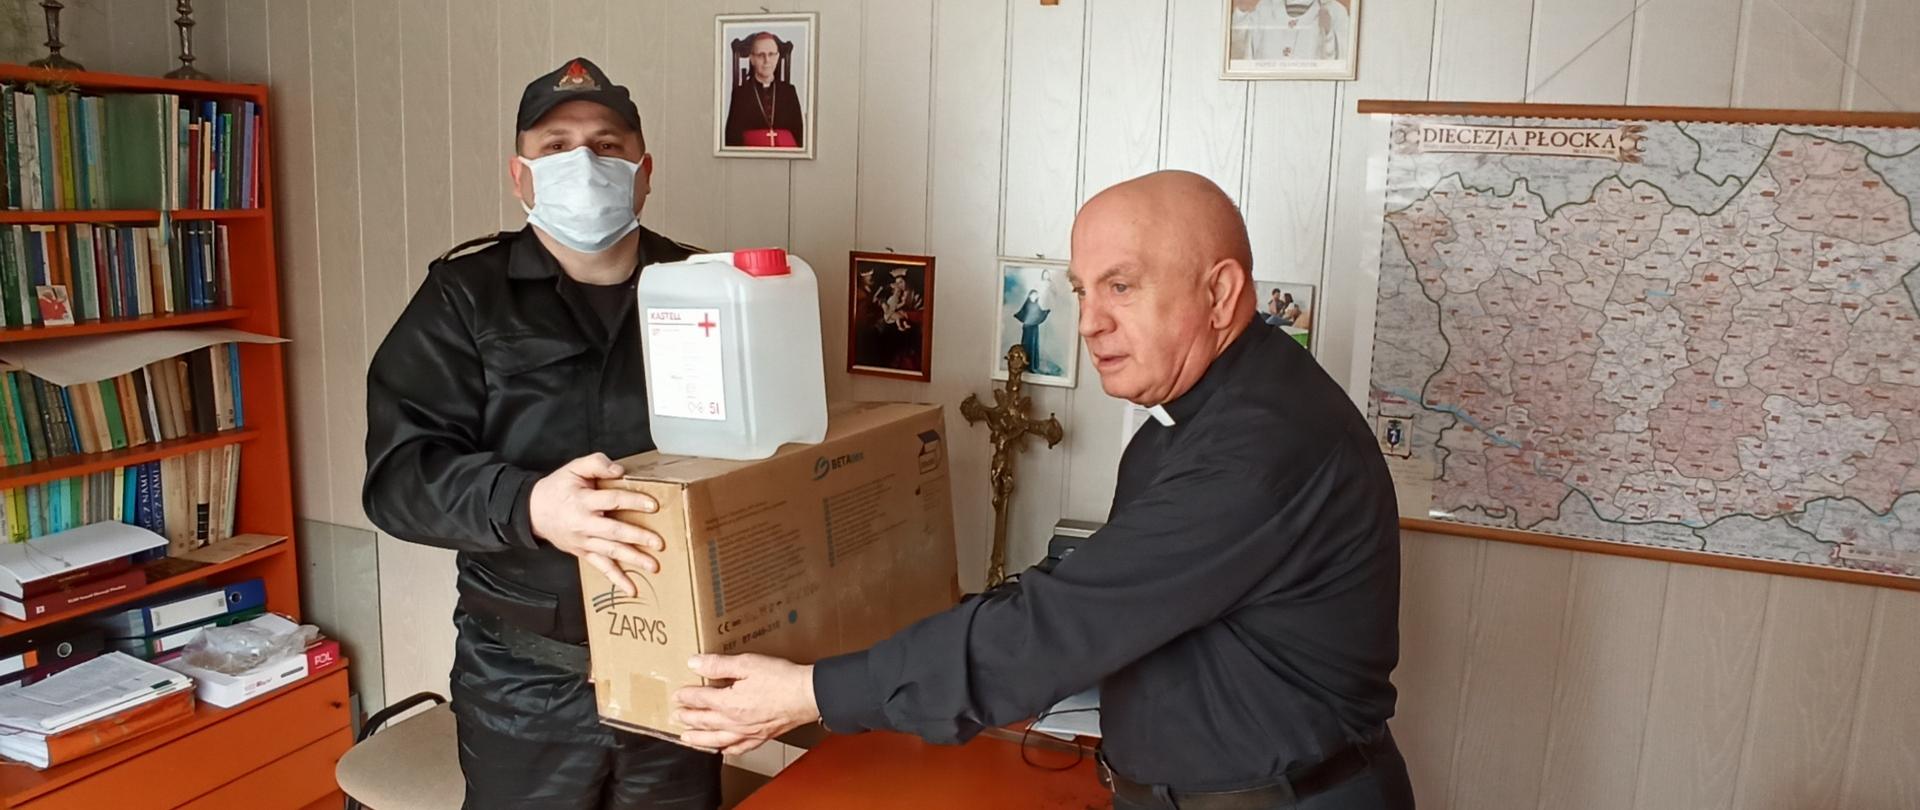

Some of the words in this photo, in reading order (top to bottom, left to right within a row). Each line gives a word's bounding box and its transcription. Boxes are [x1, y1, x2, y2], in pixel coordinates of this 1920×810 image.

[1423, 128, 1518, 149] DIECEZJA
[1525, 130, 1616, 149] PŁOCKA
[650, 312, 682, 321] KASTELL
[140, 474, 150, 503] NAMI
[607, 611, 668, 646] ZARYS
